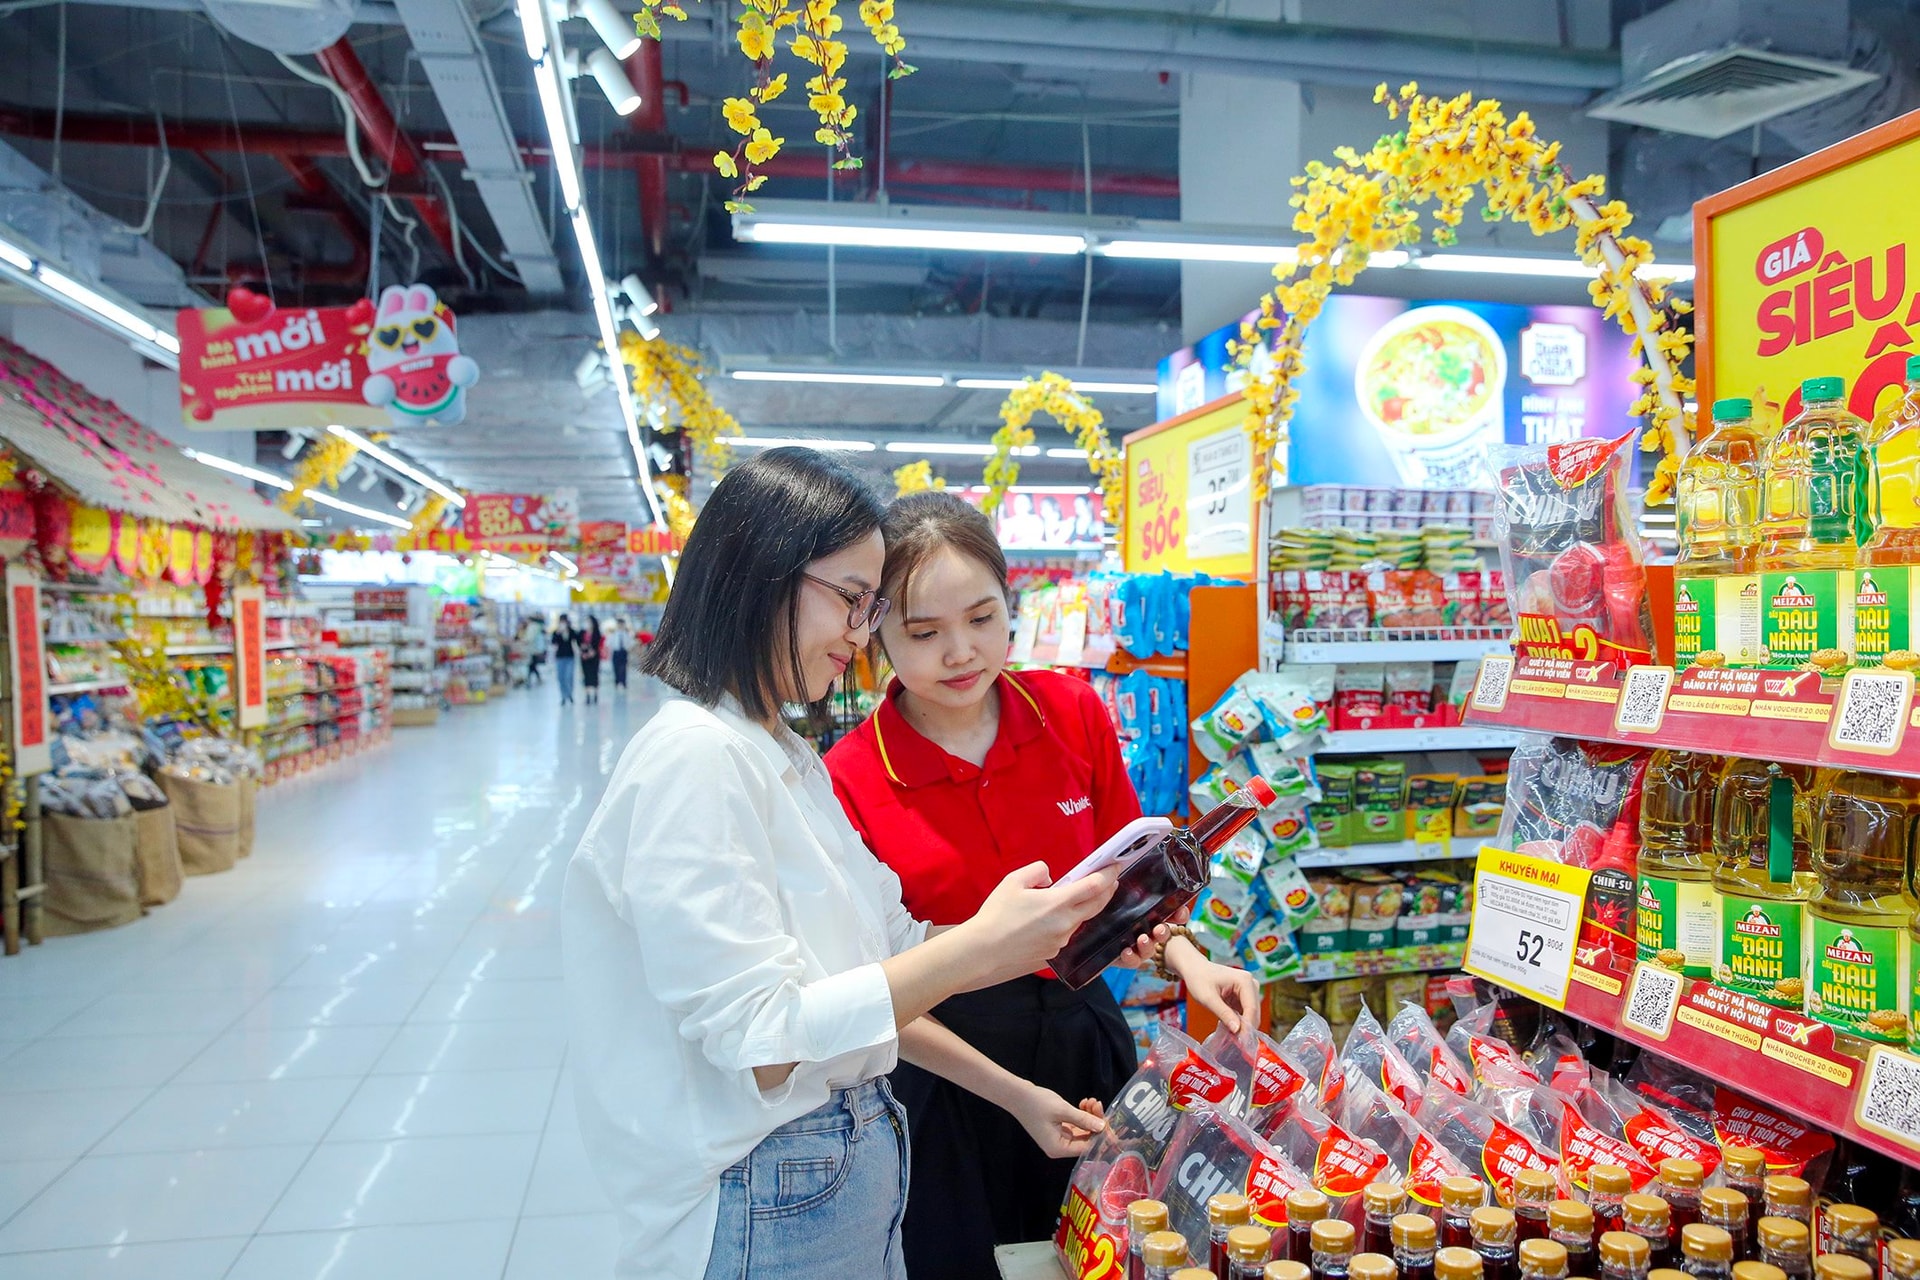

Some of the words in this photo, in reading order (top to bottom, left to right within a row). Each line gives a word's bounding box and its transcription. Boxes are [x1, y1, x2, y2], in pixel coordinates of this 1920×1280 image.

[1764, 232, 1811, 278] GIÁ
[1757, 250, 1906, 357] SIÊU
[235, 309, 325, 361] mới
[276, 359, 352, 392] mới
[1774, 597, 1814, 606] MEIZAN
[1769, 629, 1818, 651] NÀNH
[1683, 680, 1706, 690] ĐĂNG
[1706, 680, 1720, 691] KÝ
[1720, 682, 1735, 694] HỘI
[1736, 683, 1758, 693] VIÊN
[1697, 669, 1720, 681] QUÉT
[1721, 670, 1734, 681] MÃ
[1735, 671, 1760, 682] NGAY
[1773, 705, 1804, 714] VOUCHER
[1499, 860, 1539, 880] KHUYẾN
[1540, 870, 1561, 888] MẠI
[1592, 874, 1633, 891] CHIN-SU
[1736, 922, 1779, 935] MEIZAN
[1516, 929, 1544, 968] 52
[1826, 947, 1872, 964] MEIZAN
[1732, 954, 1783, 979] NÀNH
[1707, 987, 1731, 1004] QUÉT
[1731, 995, 1746, 1009] MÃ
[1746, 1001, 1772, 1017] NGAY
[1822, 981, 1876, 1011] NÀNH
[1692, 993, 1716, 1010] ĐĂNG
[1716, 1001, 1730, 1014] KÝ
[1730, 1007, 1747, 1022] HỘI
[1748, 1013, 1769, 1030] VIÊN
[1694, 1016, 1702, 1025] 10
[1784, 1047, 1817, 1067] VOUCHER
[1083, 1237, 1115, 1280] 2
